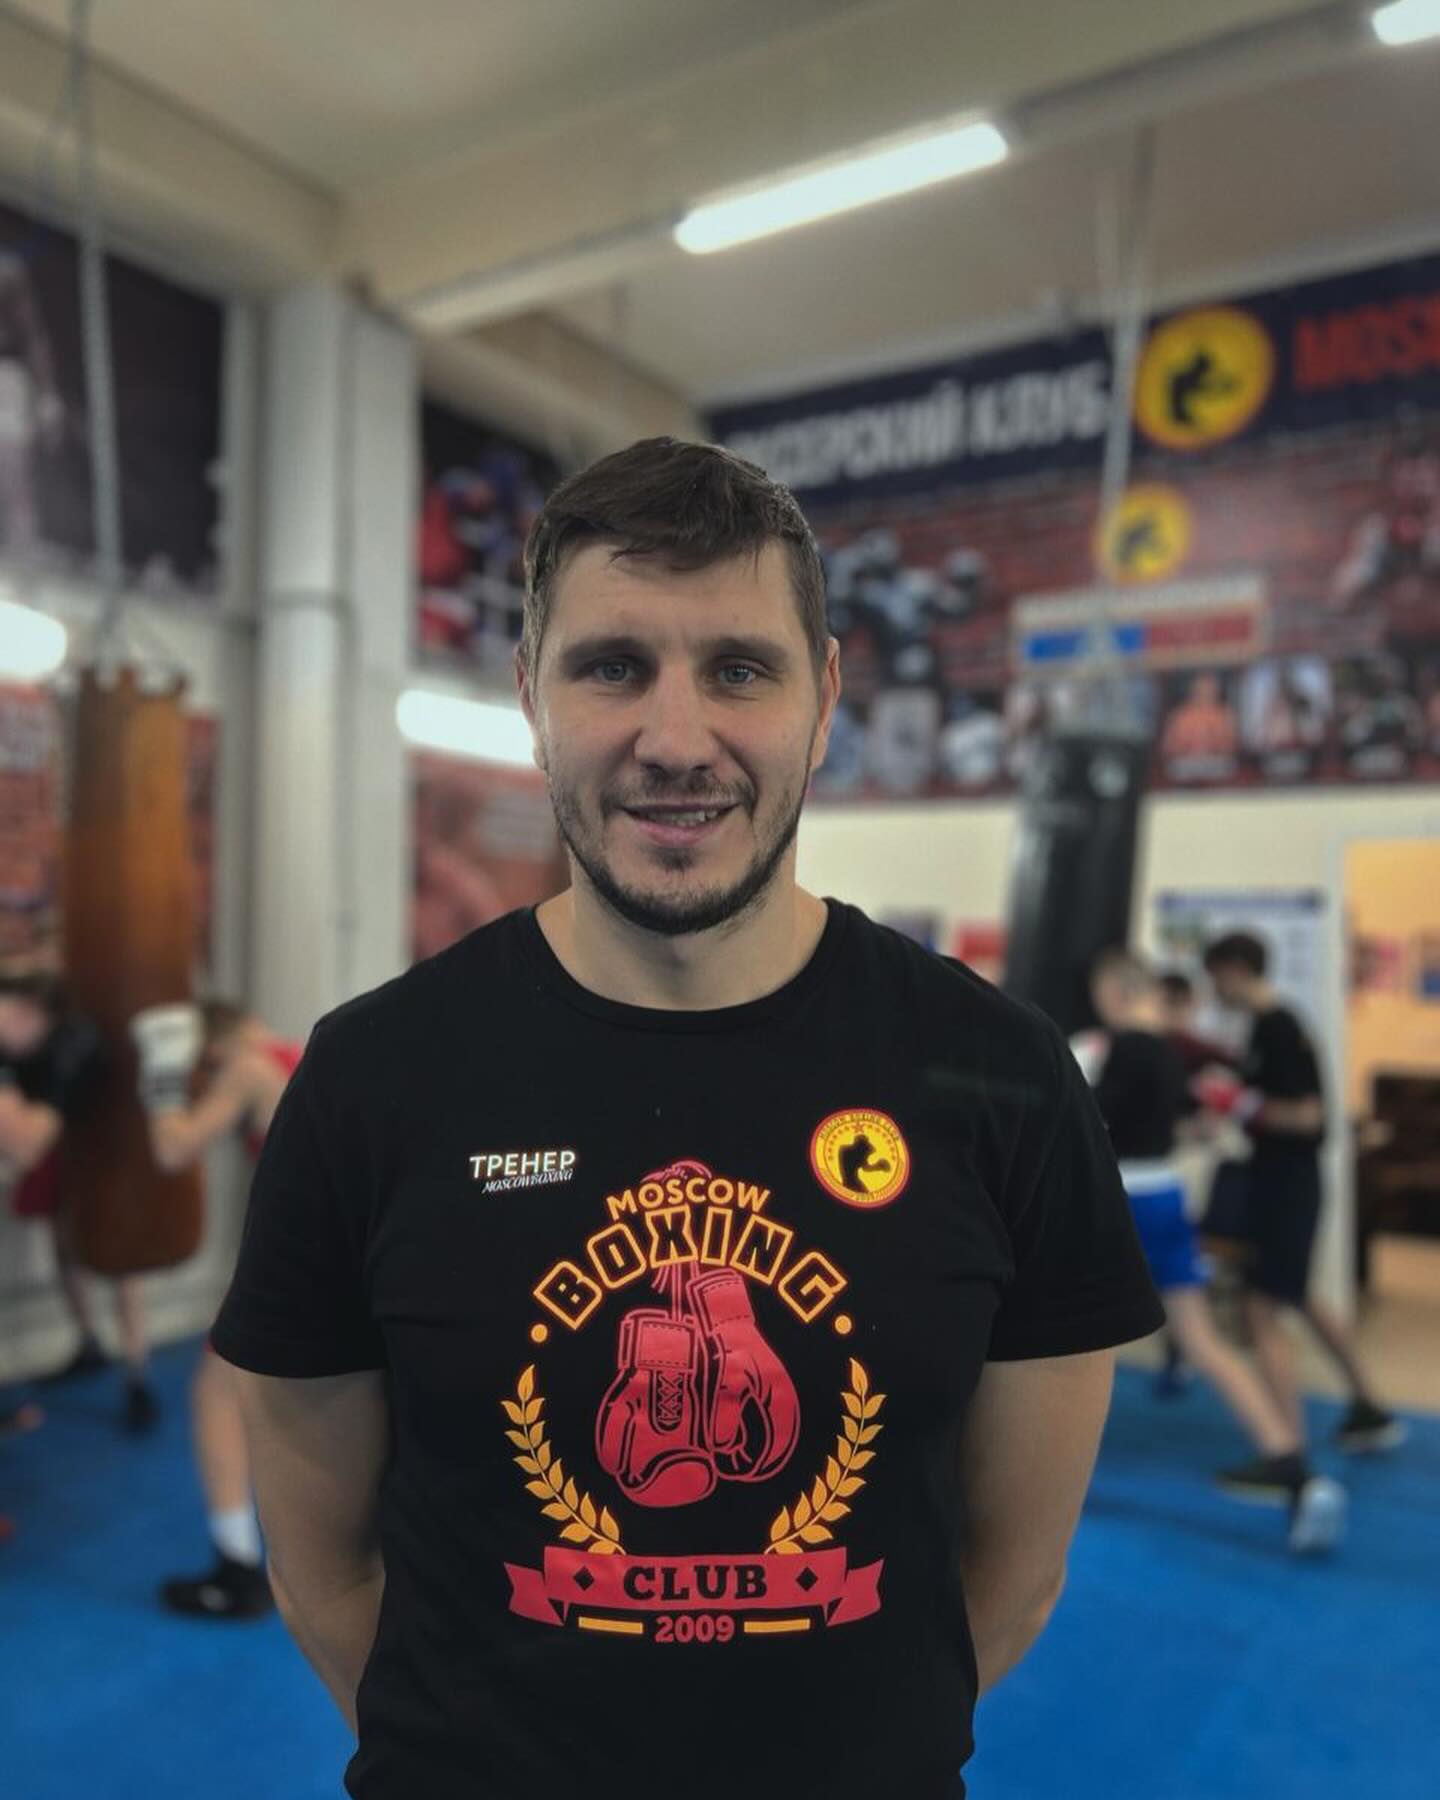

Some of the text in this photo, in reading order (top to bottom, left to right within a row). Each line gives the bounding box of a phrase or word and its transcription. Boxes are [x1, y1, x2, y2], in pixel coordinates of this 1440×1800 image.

[469, 1150, 576, 1179] ТРЕНЕР
[606, 1178, 771, 1220] MOSCOW
[533, 1205, 848, 1330] BOXING
[623, 1565, 768, 1601] CLUB
[654, 1615, 736, 1643] 2009
